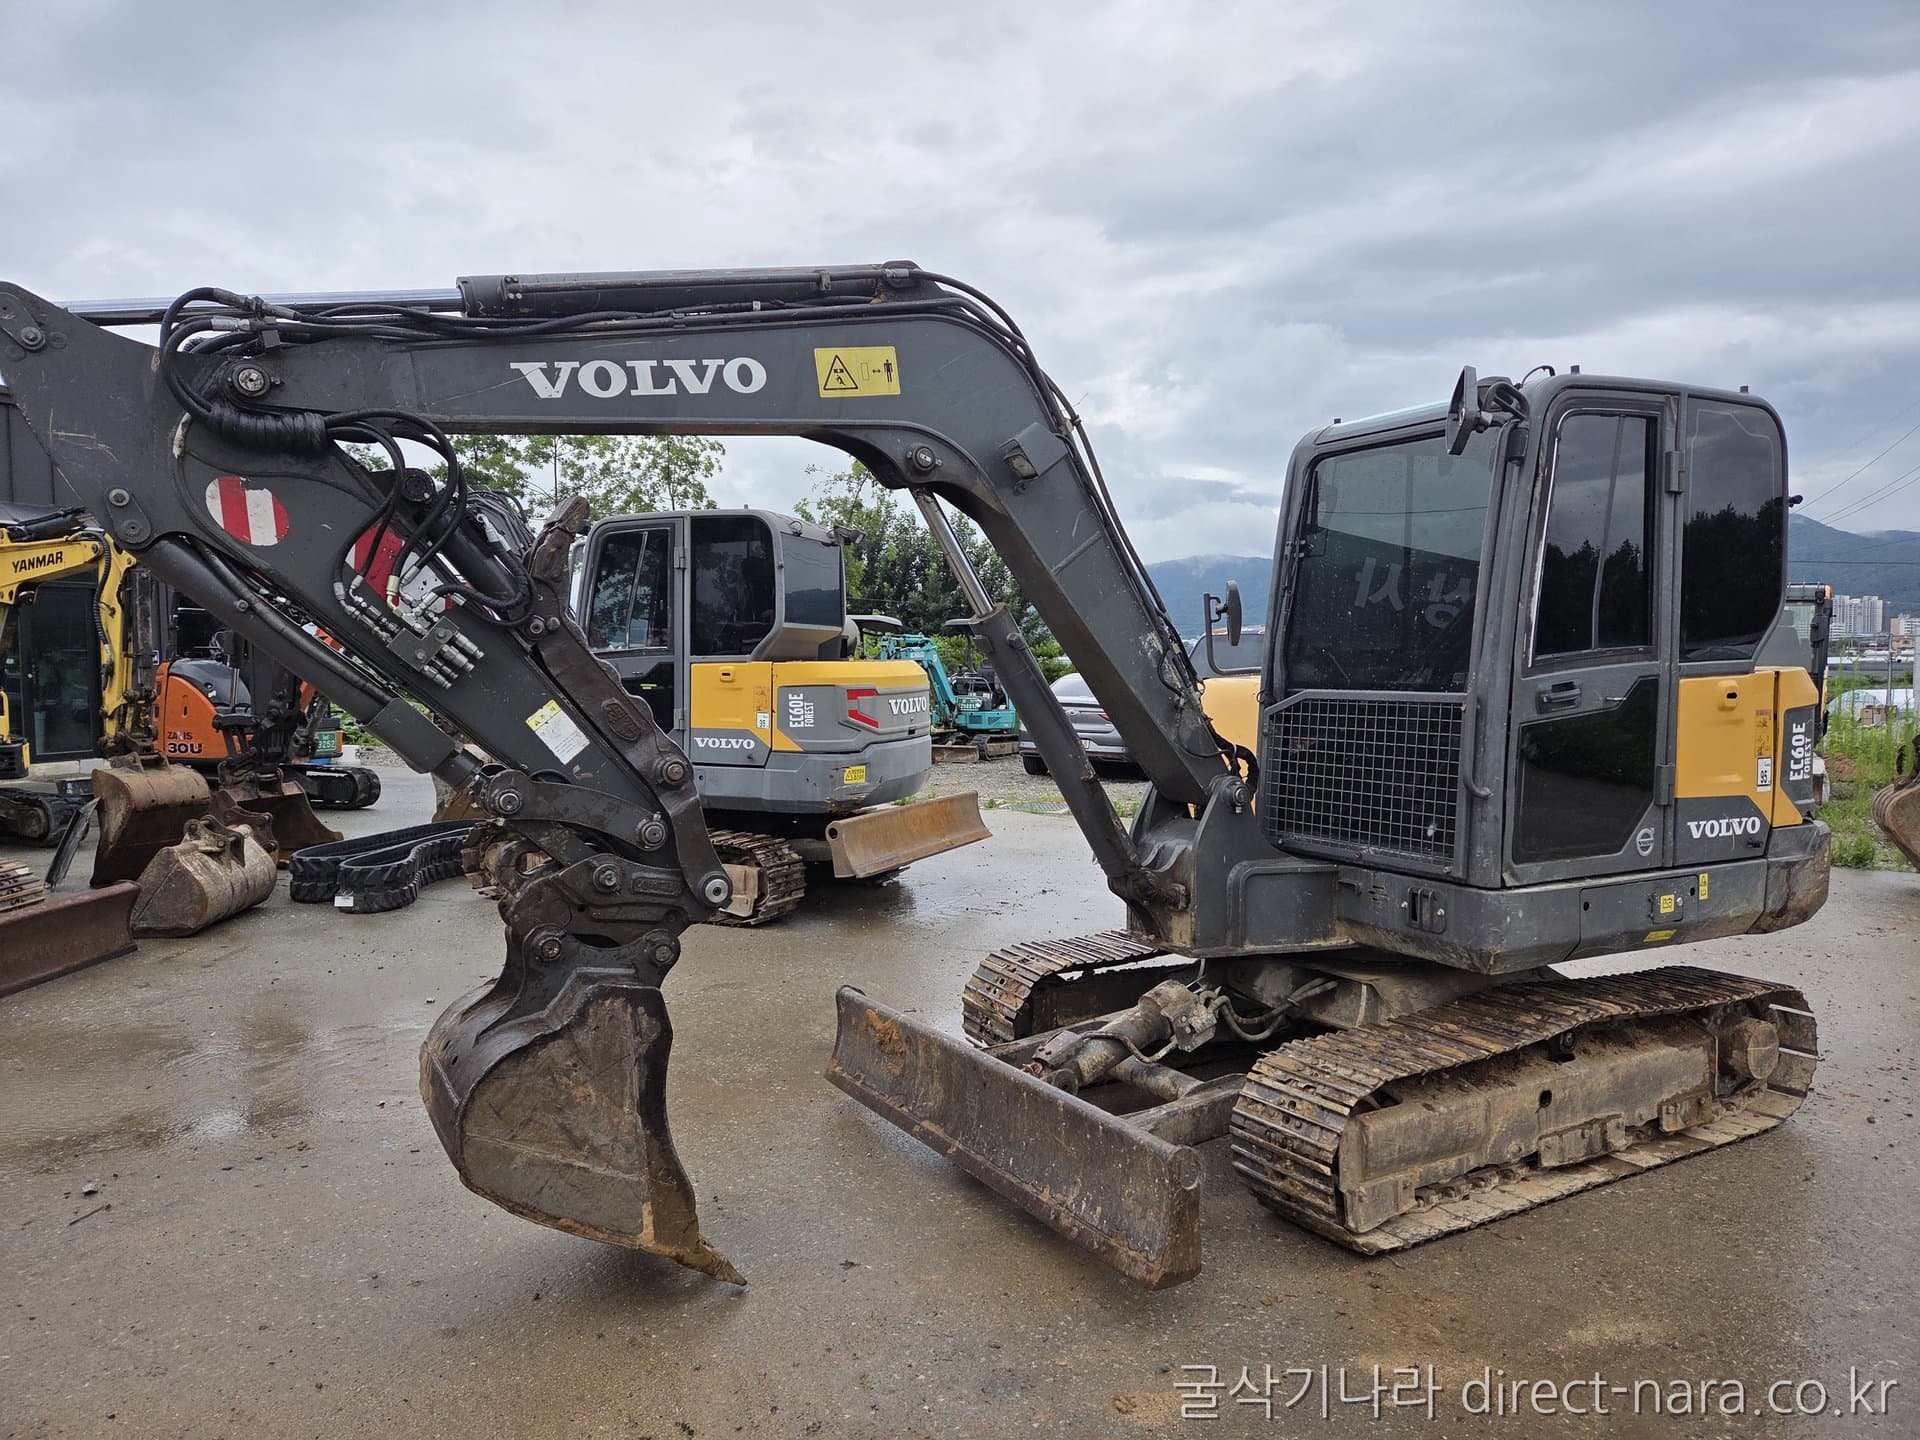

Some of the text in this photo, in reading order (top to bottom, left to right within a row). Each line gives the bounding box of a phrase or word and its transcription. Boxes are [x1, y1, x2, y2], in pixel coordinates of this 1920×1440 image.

[509, 356, 767, 398] VOLVO
[12, 550, 63, 573] YANMAR
[788, 693, 804, 728] EC60E
[888, 696, 927, 715] VOLVO
[168, 743, 203, 754] 30U
[694, 737, 755, 750] VOLVO
[1789, 722, 1806, 781] EC60E
[1803, 737, 1812, 779] FOREST
[1687, 816, 1761, 839] VOLVO
